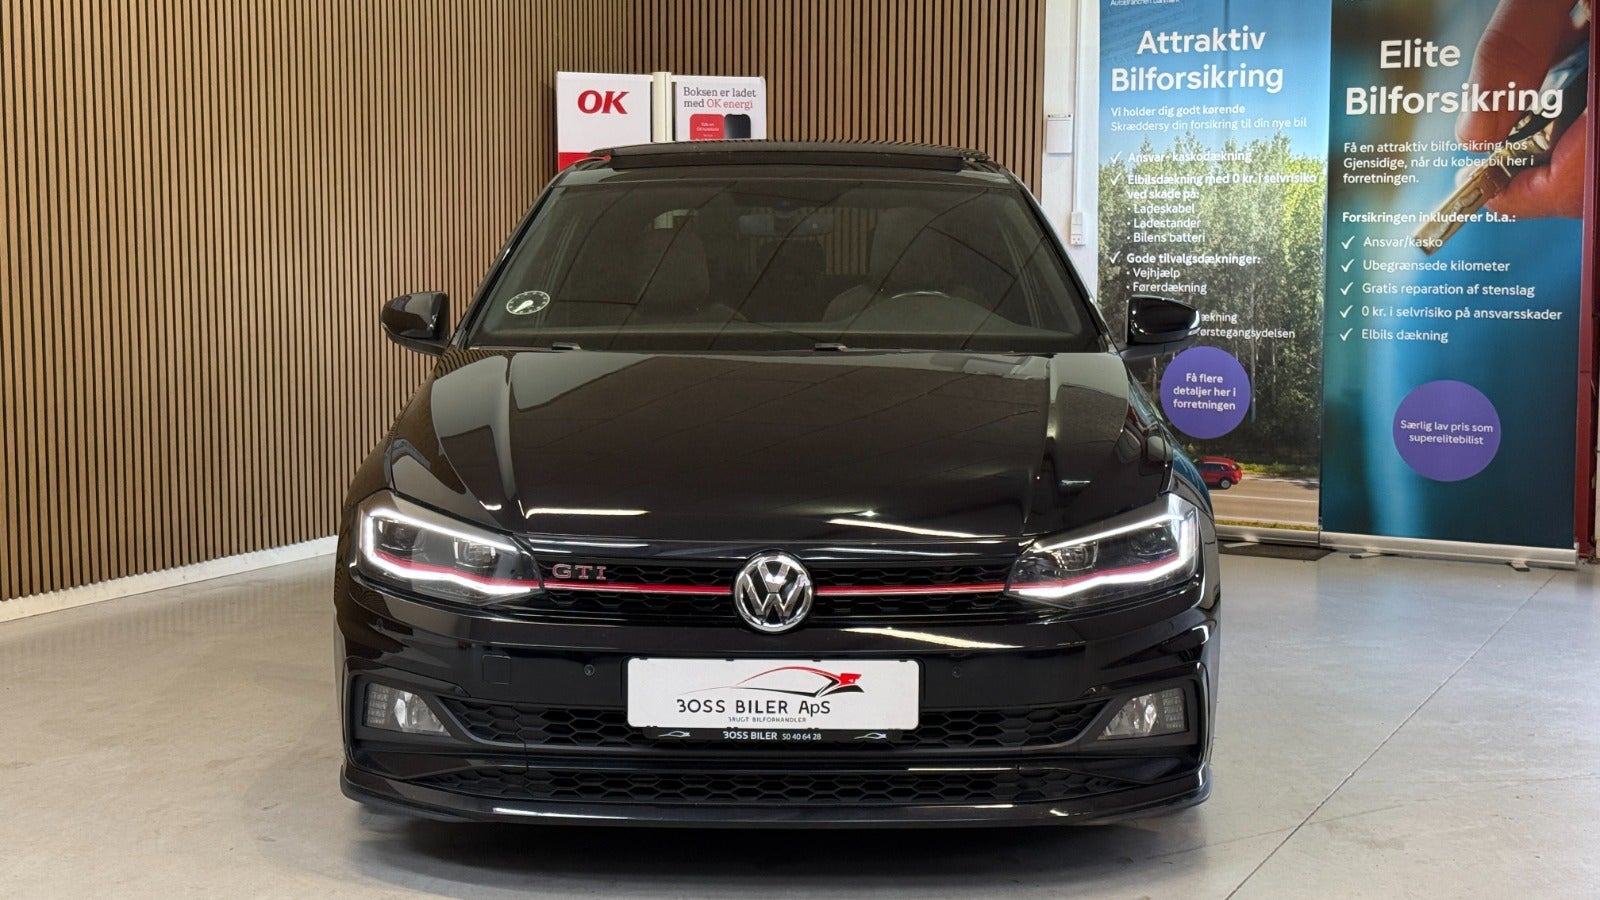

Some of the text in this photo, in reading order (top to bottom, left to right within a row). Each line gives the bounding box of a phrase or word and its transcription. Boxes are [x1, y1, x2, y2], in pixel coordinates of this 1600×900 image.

[1137, 25, 1266, 54] Attraktiv
[1380, 38, 1460, 69] Elite
[1111, 63, 1283, 93] Bilforsikring
[683, 87, 717, 97] Boksen
[732, 88, 757, 98] ladet
[577, 90, 630, 114] OK
[684, 99, 753, 110] med OK energi
[1346, 82, 1563, 118] Bilforsikring
[1111, 105, 1246, 119] Vi holder dig godt kørende
[1110, 117, 1308, 134] Skræddersy din forsikring til din nye bil
[1343, 140, 1527, 153] Få en attraktiv bilforsikring hos
[1172, 151, 1252, 163] kaskodækning
[1343, 155, 1534, 171] Gjensidige, når du køber bil her i
[1127, 174, 1203, 186] Elbilsdækning
[1205, 173, 1230, 184] med
[1232, 173, 1240, 184] 0
[1242, 174, 1256, 184] kr.
[1264, 172, 1317, 184] selvrisiko
[1343, 173, 1419, 185] forretningen.
[1127, 187, 1200, 201] ved skade på:
[1133, 204, 1195, 214] Ladeskabel
[1133, 218, 1201, 229] Ladestander
[1342, 211, 1516, 223] Forsikringen inkluderer bl.a.:
[1133, 232, 1206, 243] Bilens batteri
[1363, 235, 1443, 249] Ansvar/kasko
[1127, 253, 1261, 267] Gode tilvalgsdækninger:
[1363, 259, 1510, 274] Ubegrænsede kilometer
[1133, 268, 1180, 280] Vejhjælp
[1133, 281, 1207, 294] Førerdækning
[1362, 283, 1535, 298] Gratis reparation af stenslag
[1200, 312, 1237, 324] ækning
[1362, 306, 1370, 317] 0
[1372, 306, 1387, 317] kr.
[1396, 307, 1452, 318] selvrisiko
[1455, 307, 1470, 321] på
[1473, 308, 1562, 321] ansvarsskader
[1361, 329, 1449, 343] Elbils dækning
[1186, 372, 1224, 383] Få flere
[1173, 386, 1212, 398] detaljer
[1214, 387, 1231, 396] her
[1173, 400, 1235, 411] forretningen
[1400, 420, 1493, 434] Særlig lav pris som
[1409, 434, 1484, 445] superelitebilist
[552, 564, 607, 580] GTI
[736, 700, 788, 714] BILER
[799, 700, 831, 717] ApS
[751, 732, 777, 740] BILER
